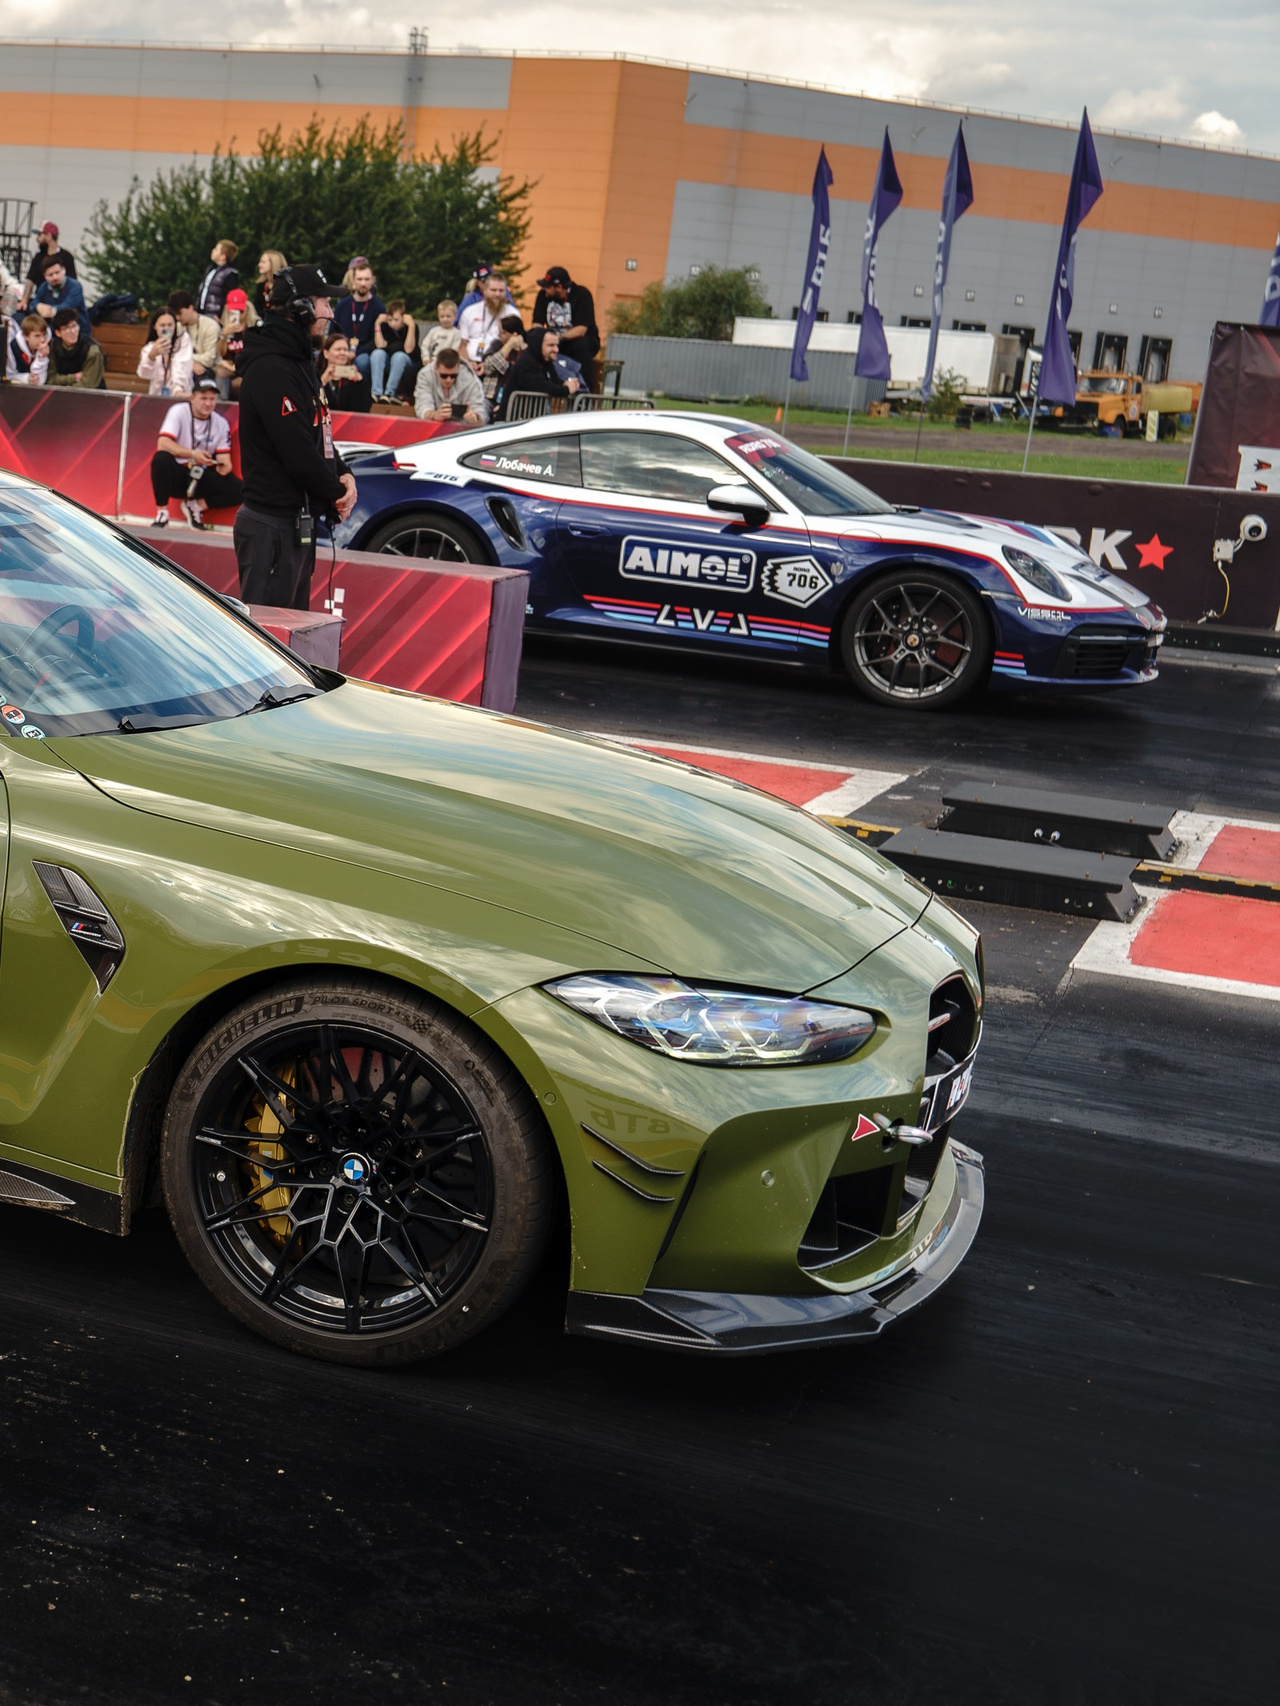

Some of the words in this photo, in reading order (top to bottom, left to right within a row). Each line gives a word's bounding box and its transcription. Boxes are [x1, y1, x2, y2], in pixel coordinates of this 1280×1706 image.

[433, 473, 458, 482] ВТБ
[496, 457, 543, 475] Лобачев
[543, 464, 555, 478] А.
[624, 545, 748, 584] AIMOL
[786, 572, 820, 590] 706
[200, 998, 297, 1073] MICHELIN
[313, 995, 349, 1006] PILOT
[352, 998, 395, 1014] SPORT
